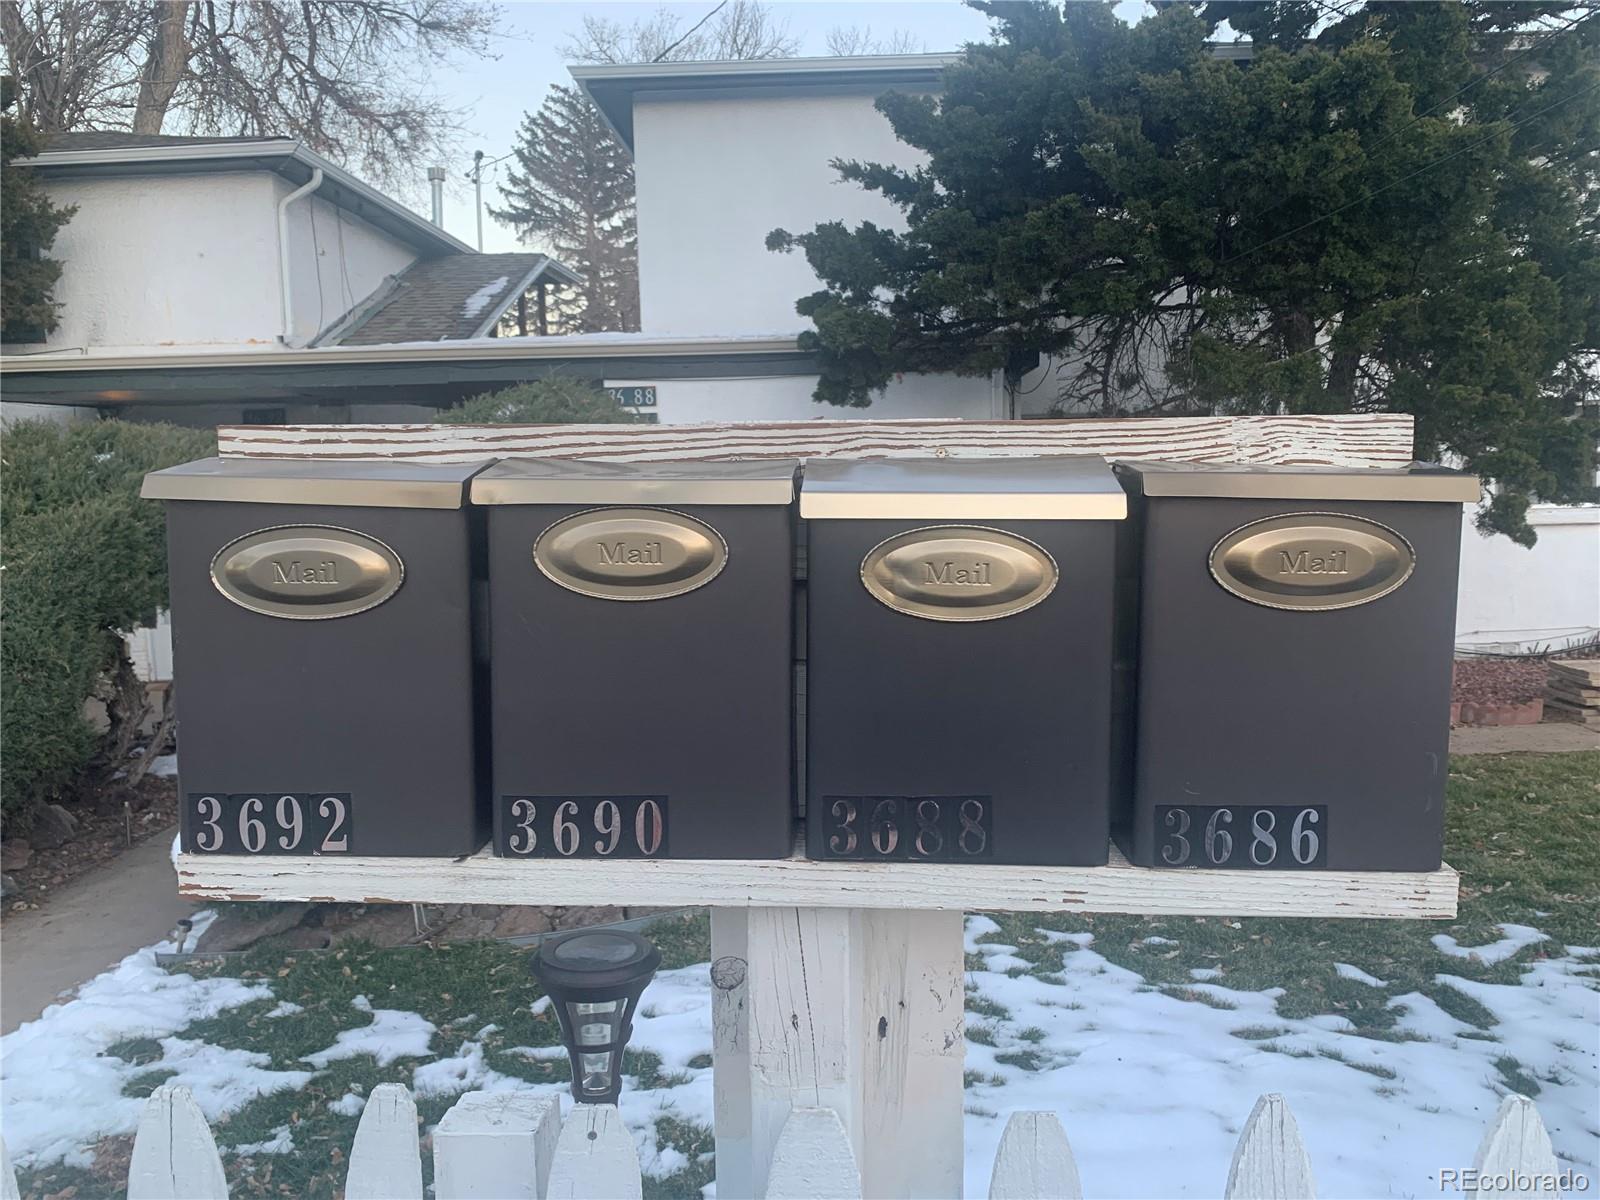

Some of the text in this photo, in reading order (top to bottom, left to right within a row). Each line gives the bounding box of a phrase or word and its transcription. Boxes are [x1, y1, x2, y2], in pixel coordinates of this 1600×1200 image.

[272, 561, 339, 584] Mail
[598, 542, 664, 566] Mail
[1279, 551, 1349, 575] Mail
[924, 562, 992, 586] Mail
[196, 795, 348, 852] 3692
[509, 799, 663, 856] 3690
[829, 800, 986, 855] 3688
[1161, 808, 1319, 866] 3686
